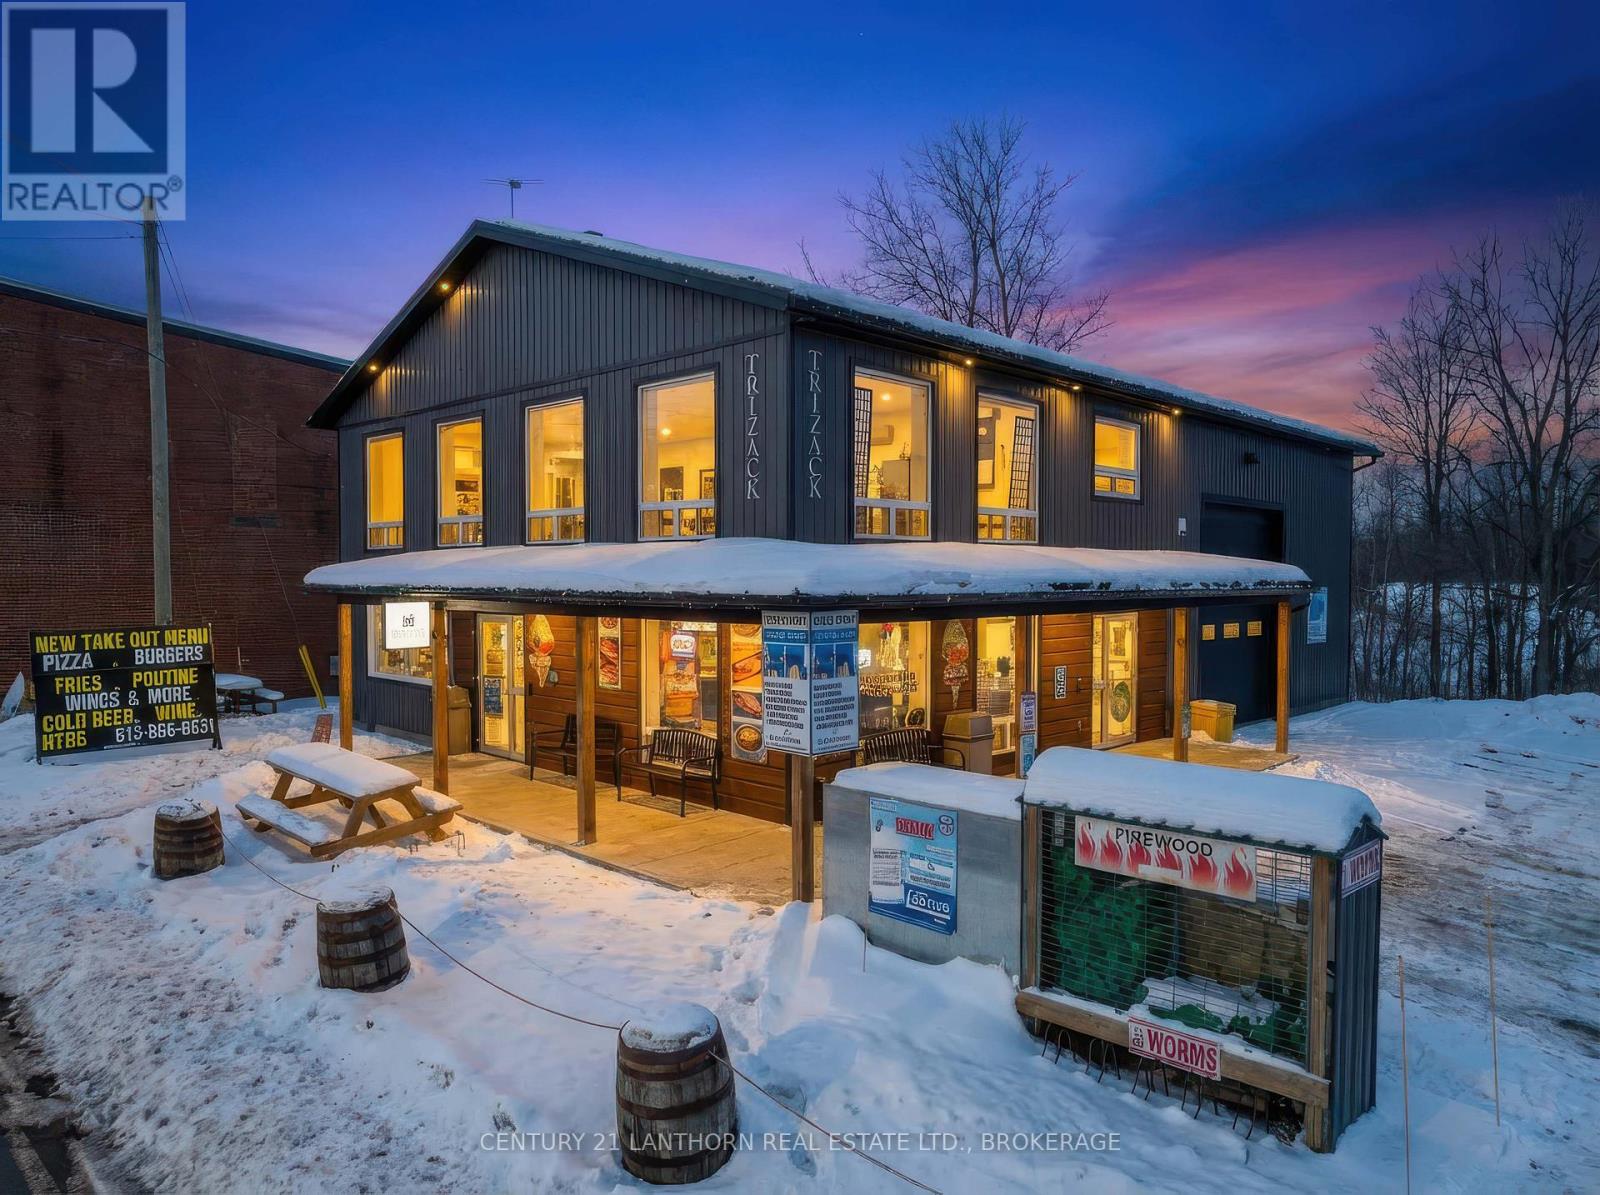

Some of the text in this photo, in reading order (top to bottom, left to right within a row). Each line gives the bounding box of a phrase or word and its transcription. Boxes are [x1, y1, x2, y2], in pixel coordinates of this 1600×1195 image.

[745, 353, 760, 499] TRIZACK
[808, 350, 823, 499] TRIZACK
[35, 634, 76, 653] NEW
[81, 632, 125, 650] TAKE
[130, 630, 160, 648] OUT
[43, 645, 204, 672] PIZZA BURGERS
[55, 668, 199, 695] FRIES POUTINE
[65, 686, 193, 711] WINGS & MORE
[1146, 1028, 1218, 1072] WORMS
